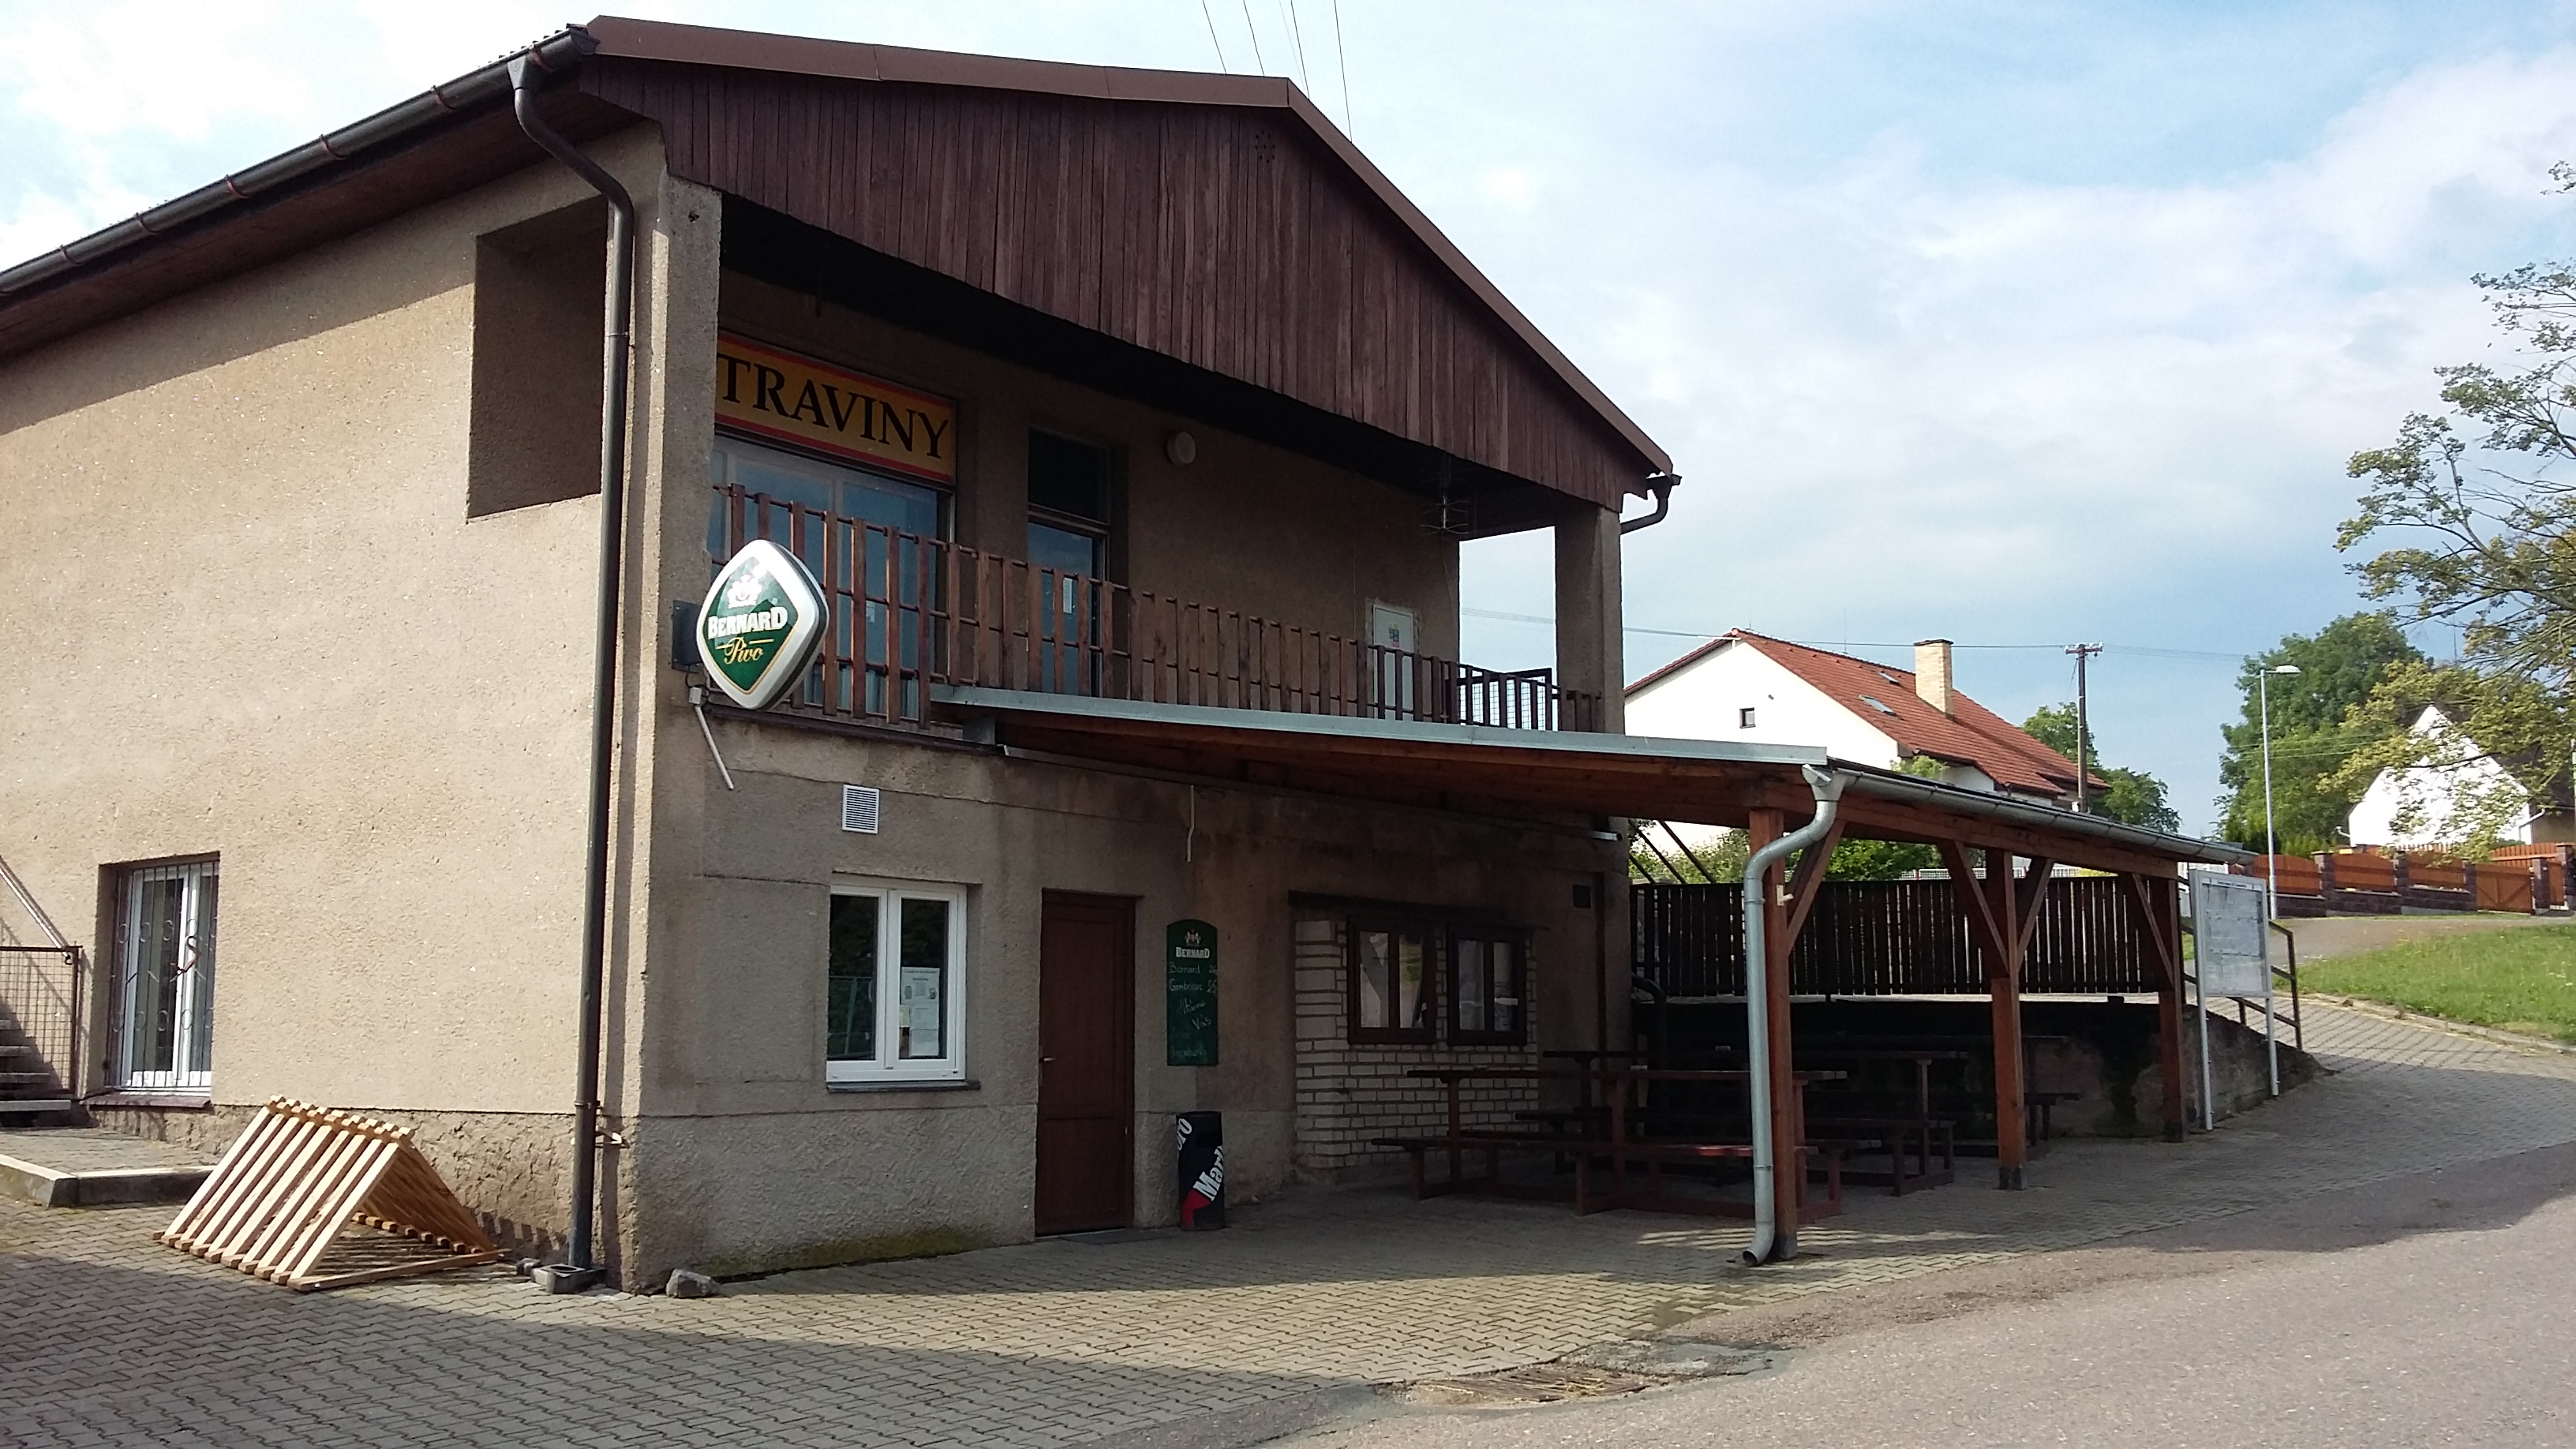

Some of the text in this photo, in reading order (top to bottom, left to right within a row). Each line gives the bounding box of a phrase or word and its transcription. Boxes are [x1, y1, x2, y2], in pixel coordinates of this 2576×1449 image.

[716, 354, 948, 459] TRAVINY
[708, 606, 788, 640] BERNARD
[1175, 947, 1211, 959] BERNARD
